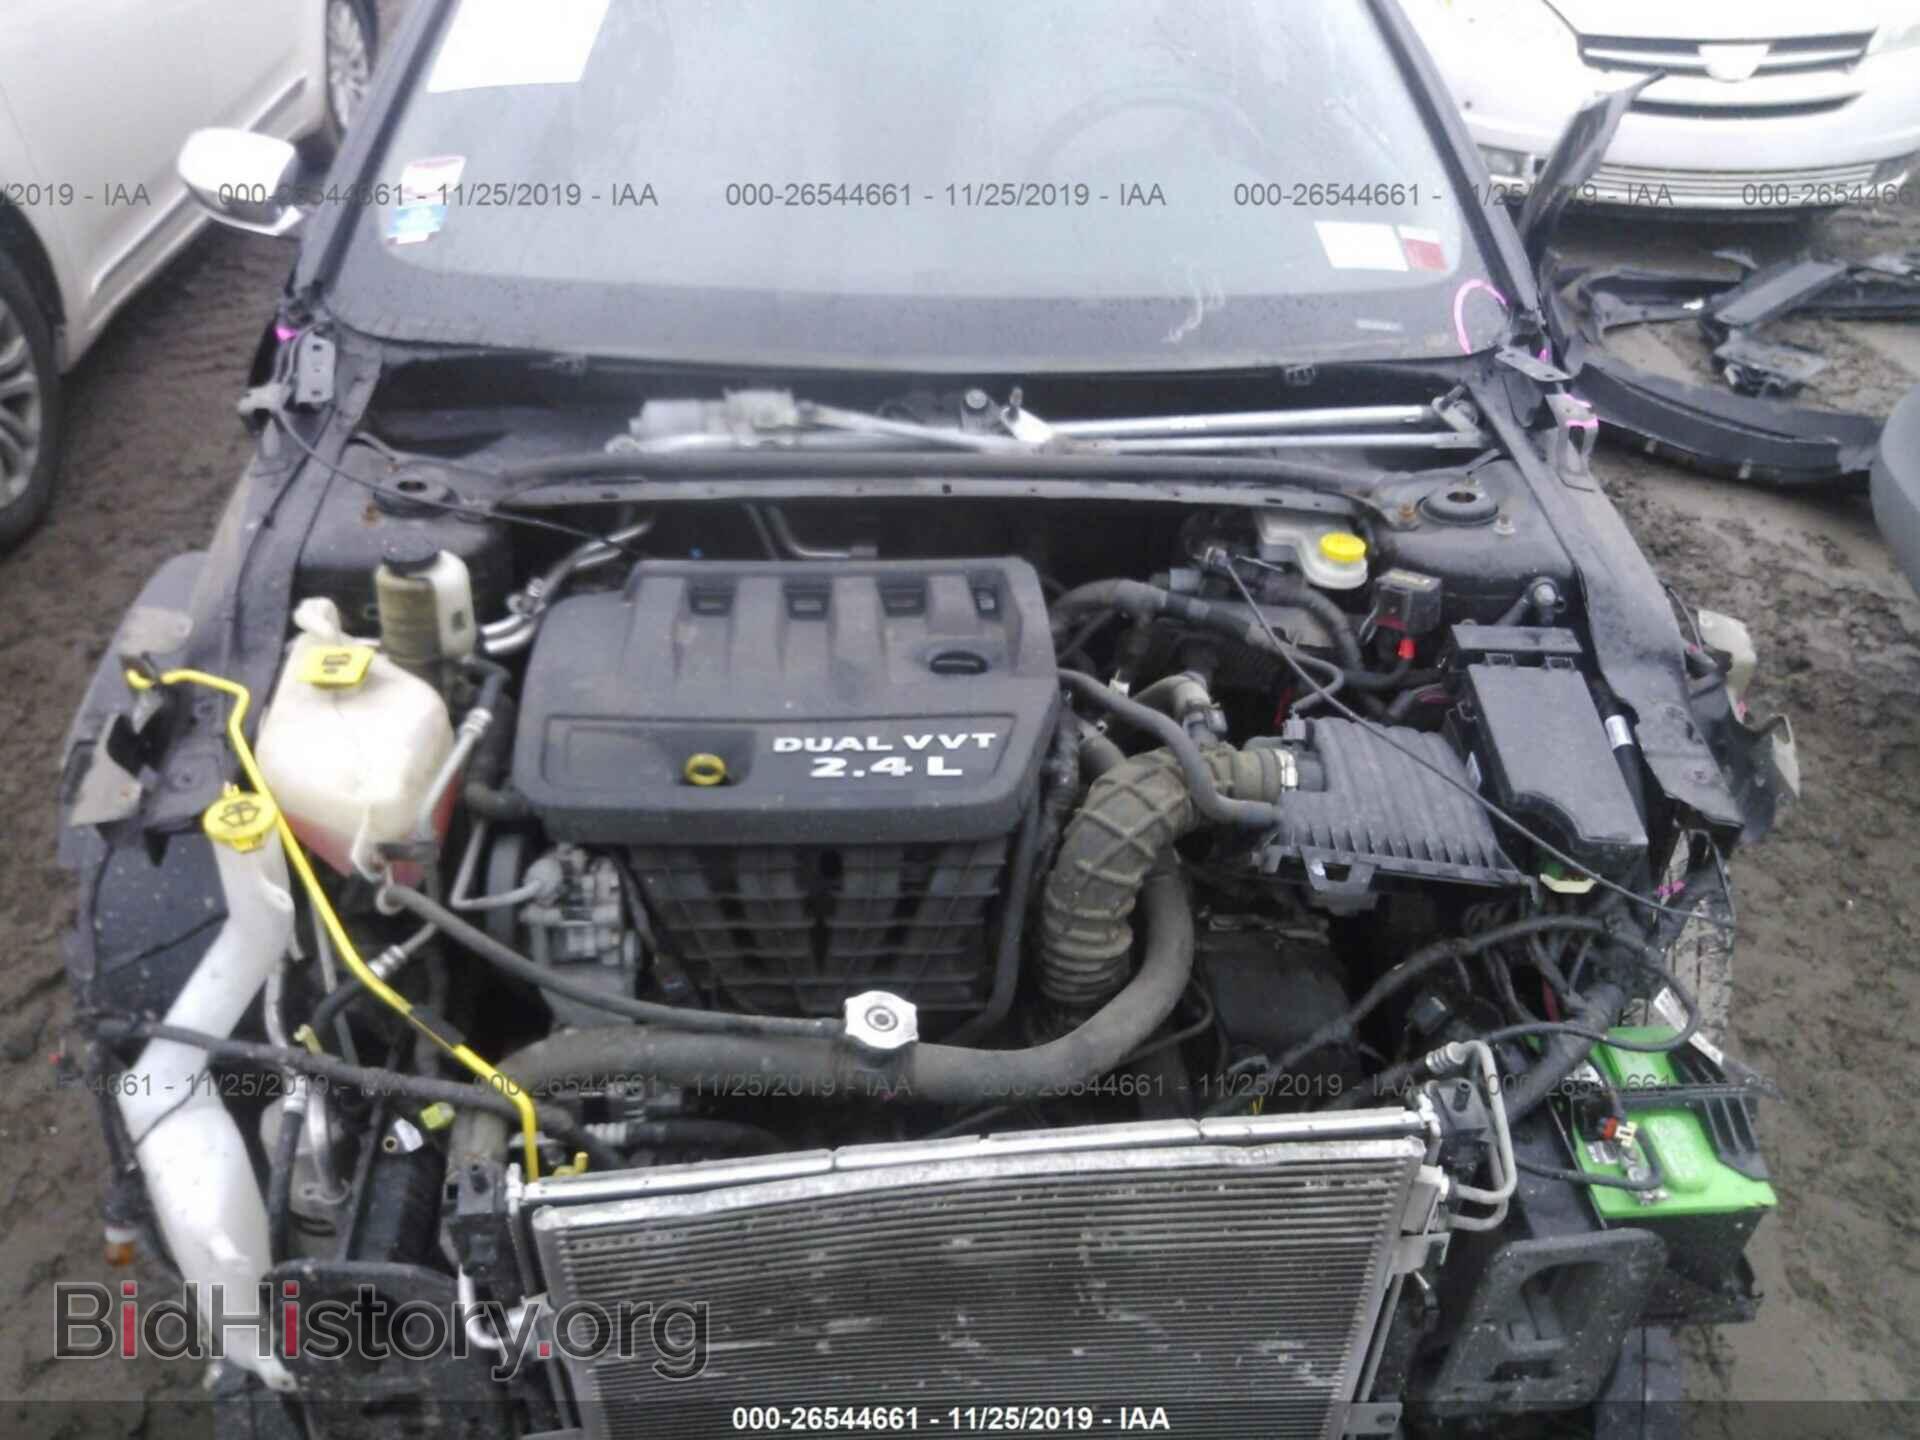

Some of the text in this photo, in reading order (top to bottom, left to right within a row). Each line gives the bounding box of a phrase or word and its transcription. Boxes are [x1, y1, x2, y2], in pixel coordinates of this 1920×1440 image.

[773, 732, 997, 752] DUAL VVT
[810, 756, 963, 777] 2.4 L
